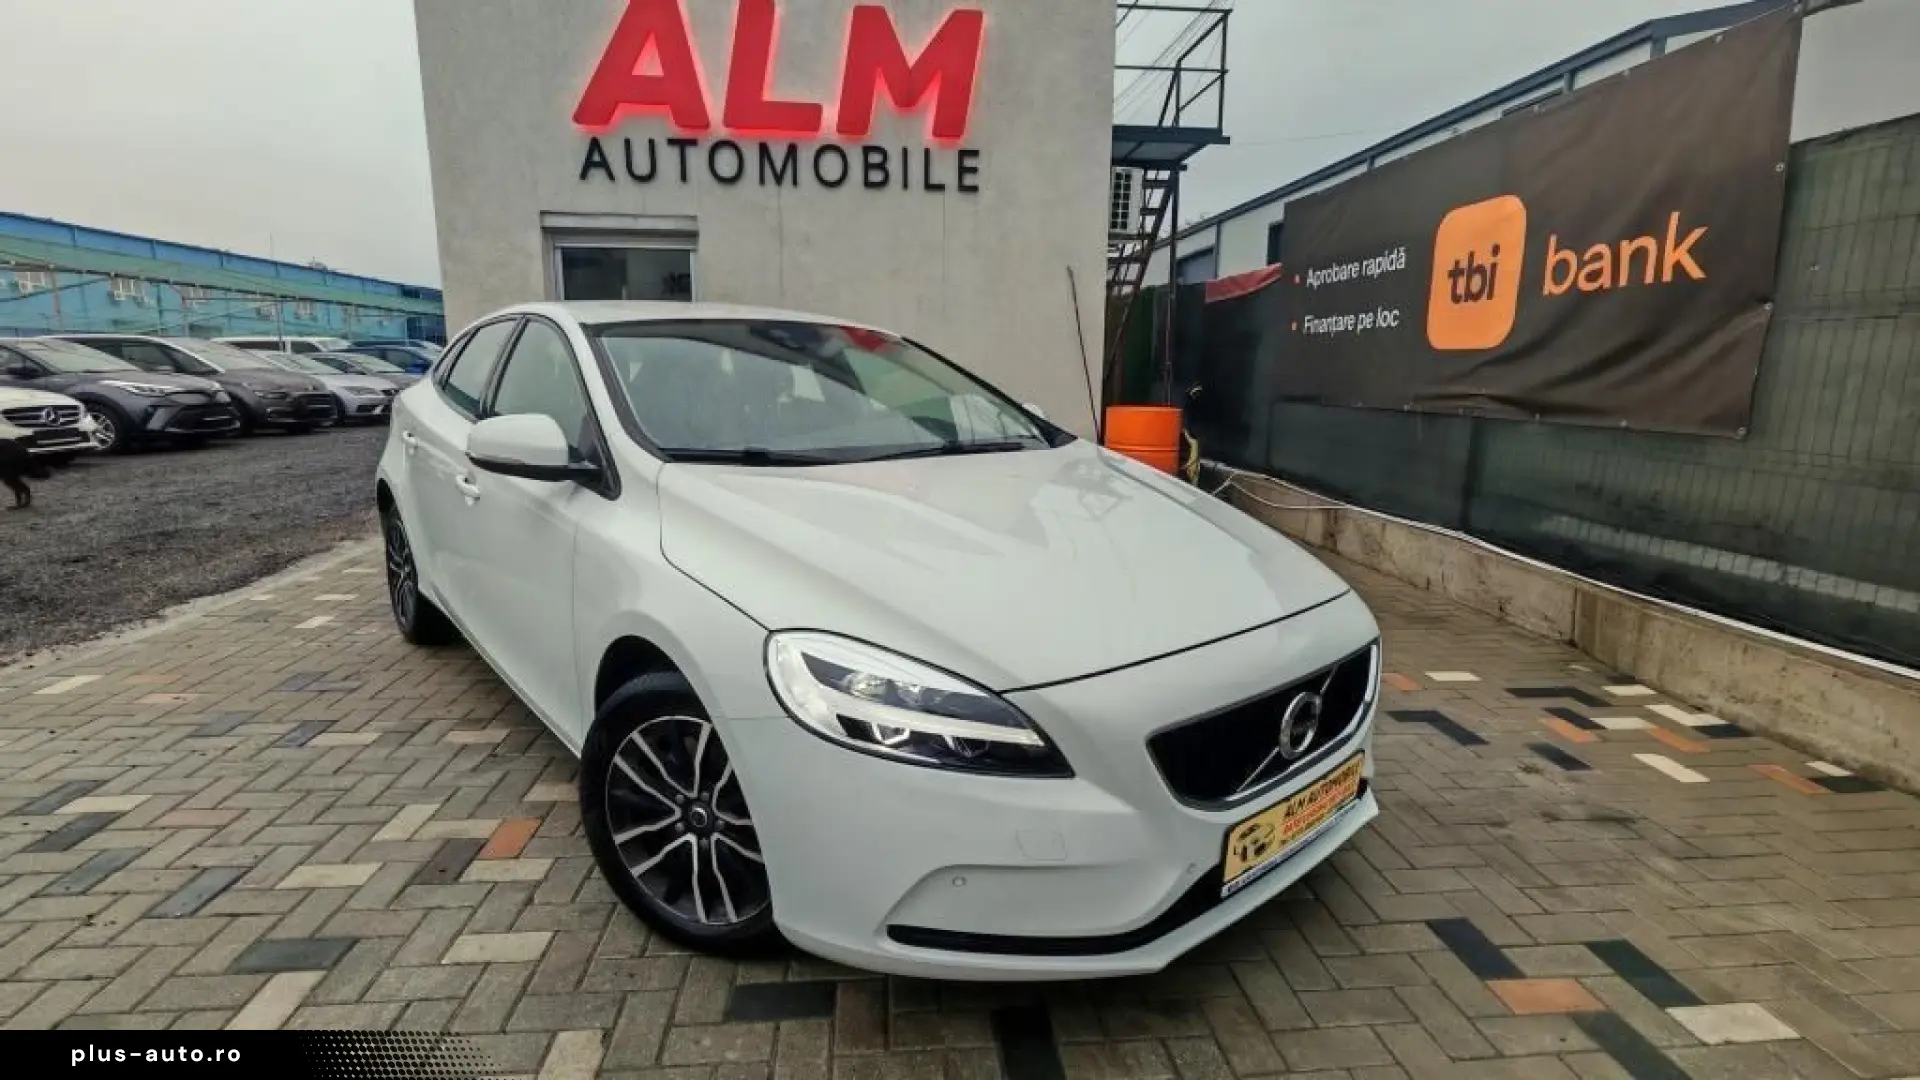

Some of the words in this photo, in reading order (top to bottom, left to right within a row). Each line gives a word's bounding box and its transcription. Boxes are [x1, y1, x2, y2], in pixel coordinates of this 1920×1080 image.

[573, 0, 984, 139] ALM
[579, 136, 981, 194] AUTOMOBILE
[1306, 262, 1360, 291] Aprobare
[1362, 246, 1406, 279] rapidă
[1447, 243, 1501, 305] tbi
[1542, 211, 1709, 296] bank
[1356, 311, 1375, 335] pe
[1375, 306, 1400, 329] loc
